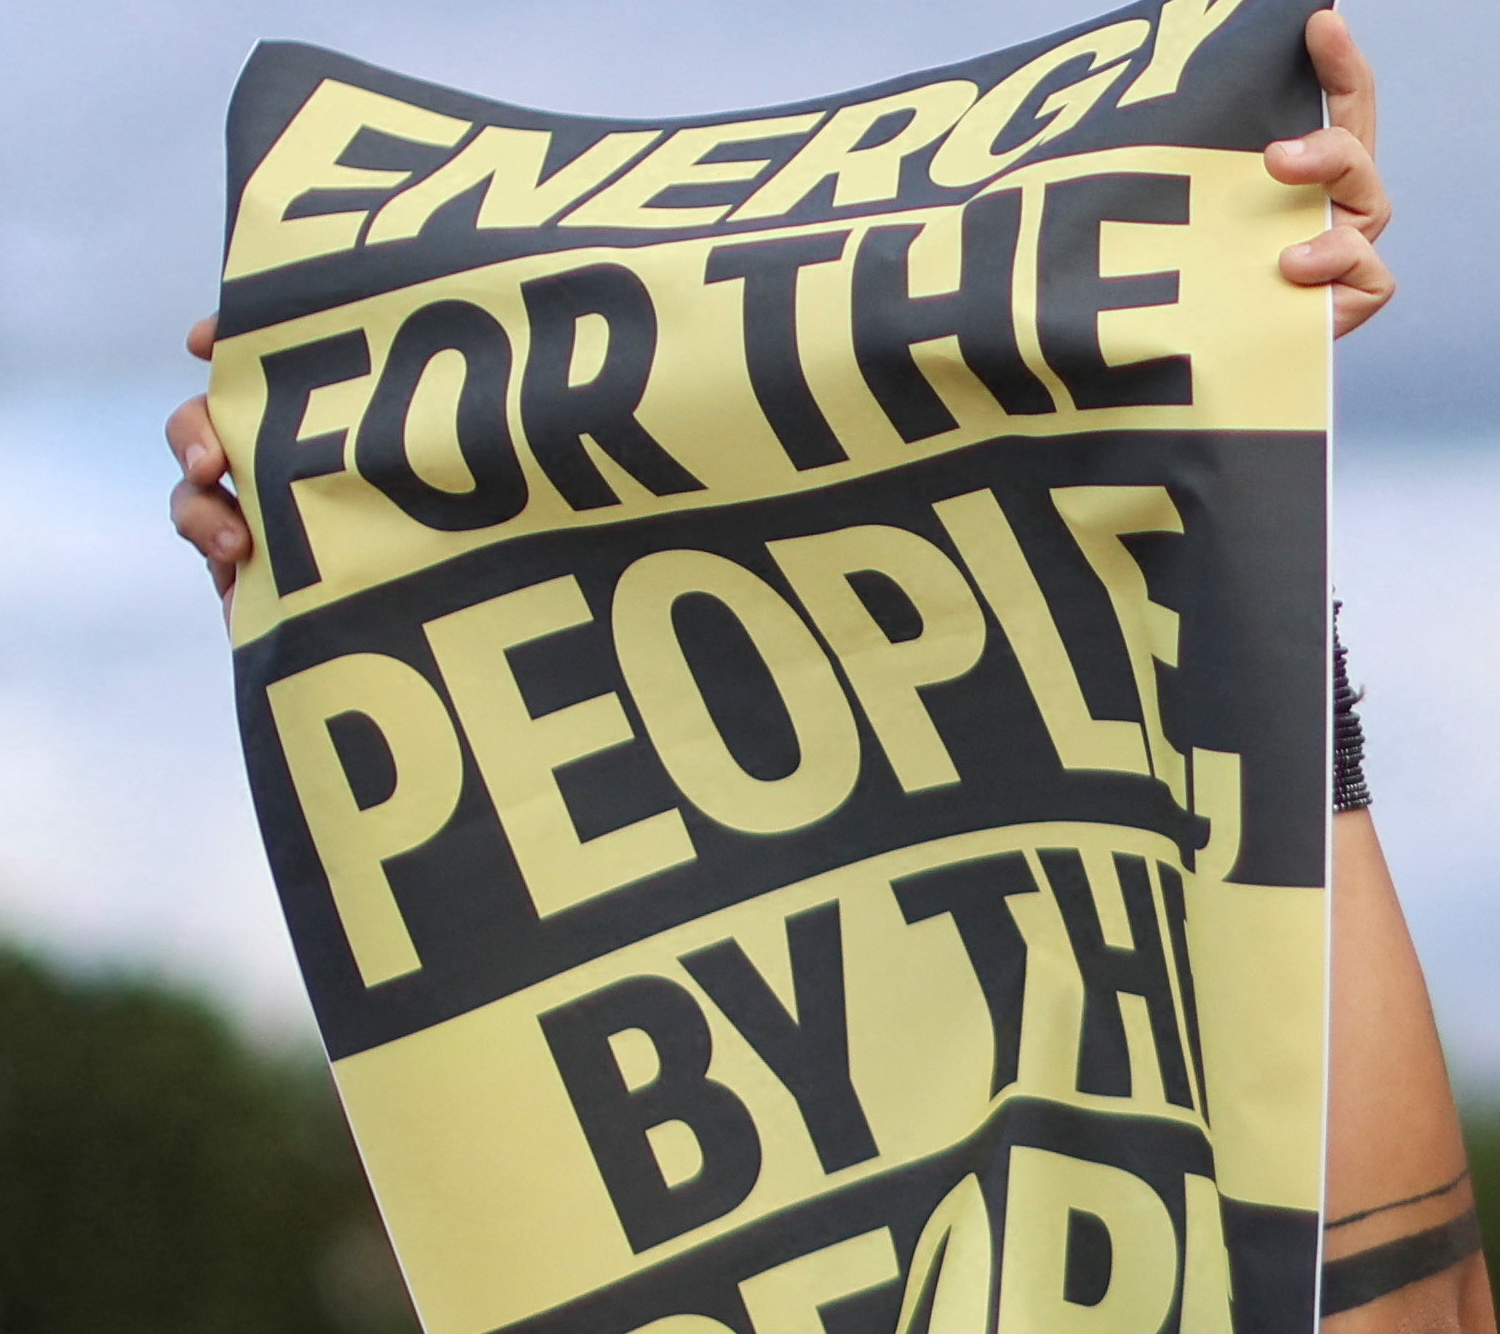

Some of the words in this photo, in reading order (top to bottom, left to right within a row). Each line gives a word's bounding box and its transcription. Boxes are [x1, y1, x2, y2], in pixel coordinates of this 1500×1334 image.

[260, 263, 707, 597] FOR
[706, 174, 1193, 470] THE
[537, 899, 880, 1255] BY
